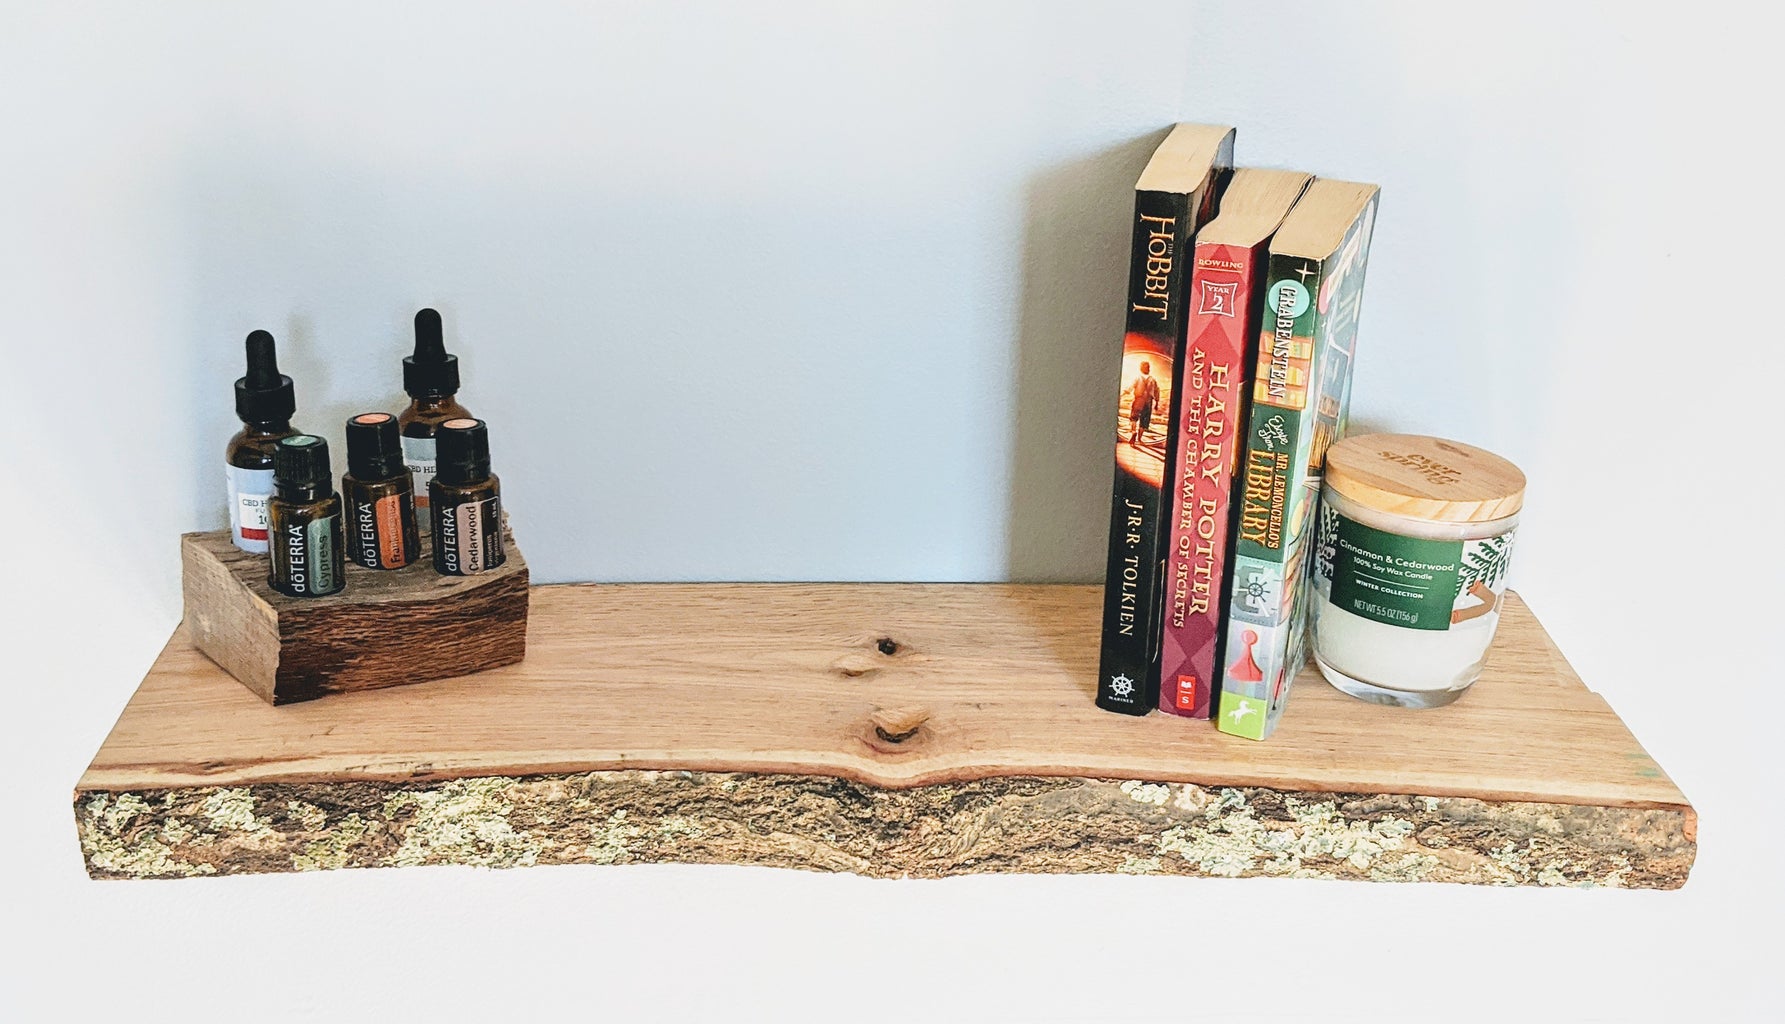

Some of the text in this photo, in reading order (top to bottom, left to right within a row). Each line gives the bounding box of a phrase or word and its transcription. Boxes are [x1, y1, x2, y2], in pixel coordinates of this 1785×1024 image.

[1133, 213, 1176, 320] HOBBIT
[1198, 258, 1243, 269] ROWLING
[1207, 285, 1229, 295] YEAR
[1211, 292, 1223, 313] 2
[1268, 285, 1298, 399] GRABENSTEIN
[1268, 415, 1288, 445] Escape
[242, 499, 259, 507] CBD
[1173, 347, 1206, 628] AND THE CHAMBER OF SECRETS
[1188, 361, 1230, 616] HARRY POTTER
[1240, 450, 1275, 548] LIBRARY
[1268, 452, 1289, 550] MR. LEMONCELLO'S
[466, 506, 479, 571] Cedarwood
[317, 535, 331, 589] Cypress
[1340, 540, 1454, 572] Cinnamon & Cedarwood
[1353, 556, 1433, 580] 100% Soy Wax Candle
[1119, 555, 1139, 637] TOLKIEN
[1355, 579, 1424, 599] WINTER COLLECTION
[1354, 598, 1366, 609] NET
[1366, 602, 1376, 613] WT
[1376, 605, 1386, 616] 5.5
[1386, 608, 1396, 618] OZ
[1181, 696, 1190, 704] S
